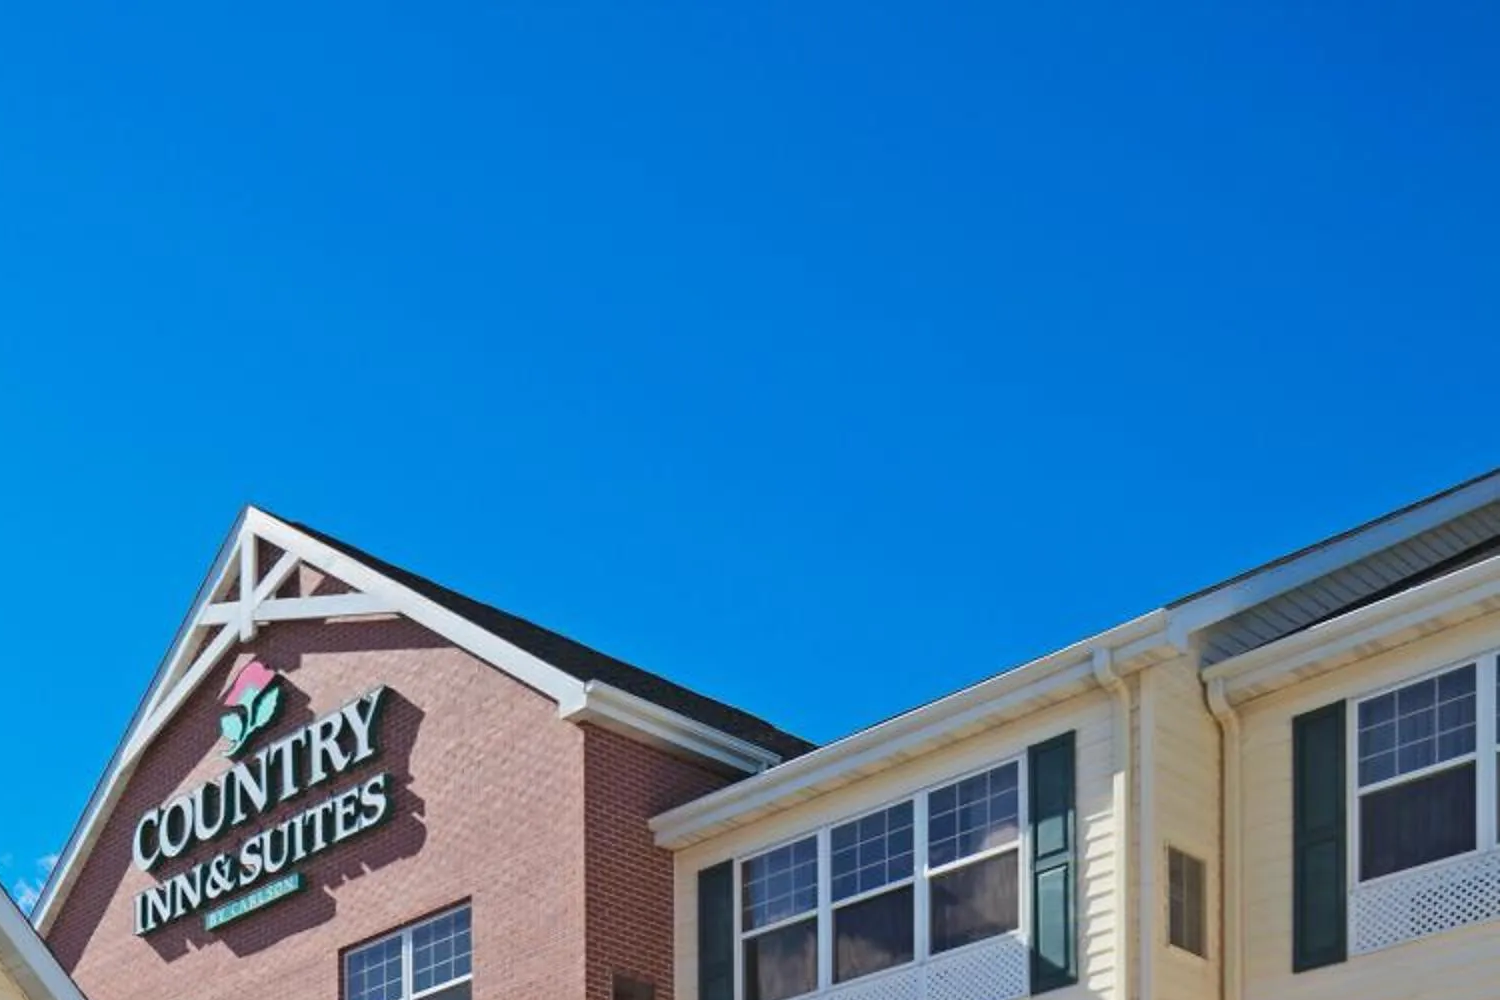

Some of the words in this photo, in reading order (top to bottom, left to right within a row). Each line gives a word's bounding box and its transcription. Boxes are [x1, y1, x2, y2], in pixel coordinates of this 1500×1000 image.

[132, 685, 384, 872] COUNTRY
[134, 863, 203, 935] INN
[205, 854, 236, 899] &
[238, 773, 387, 886] SUITES
